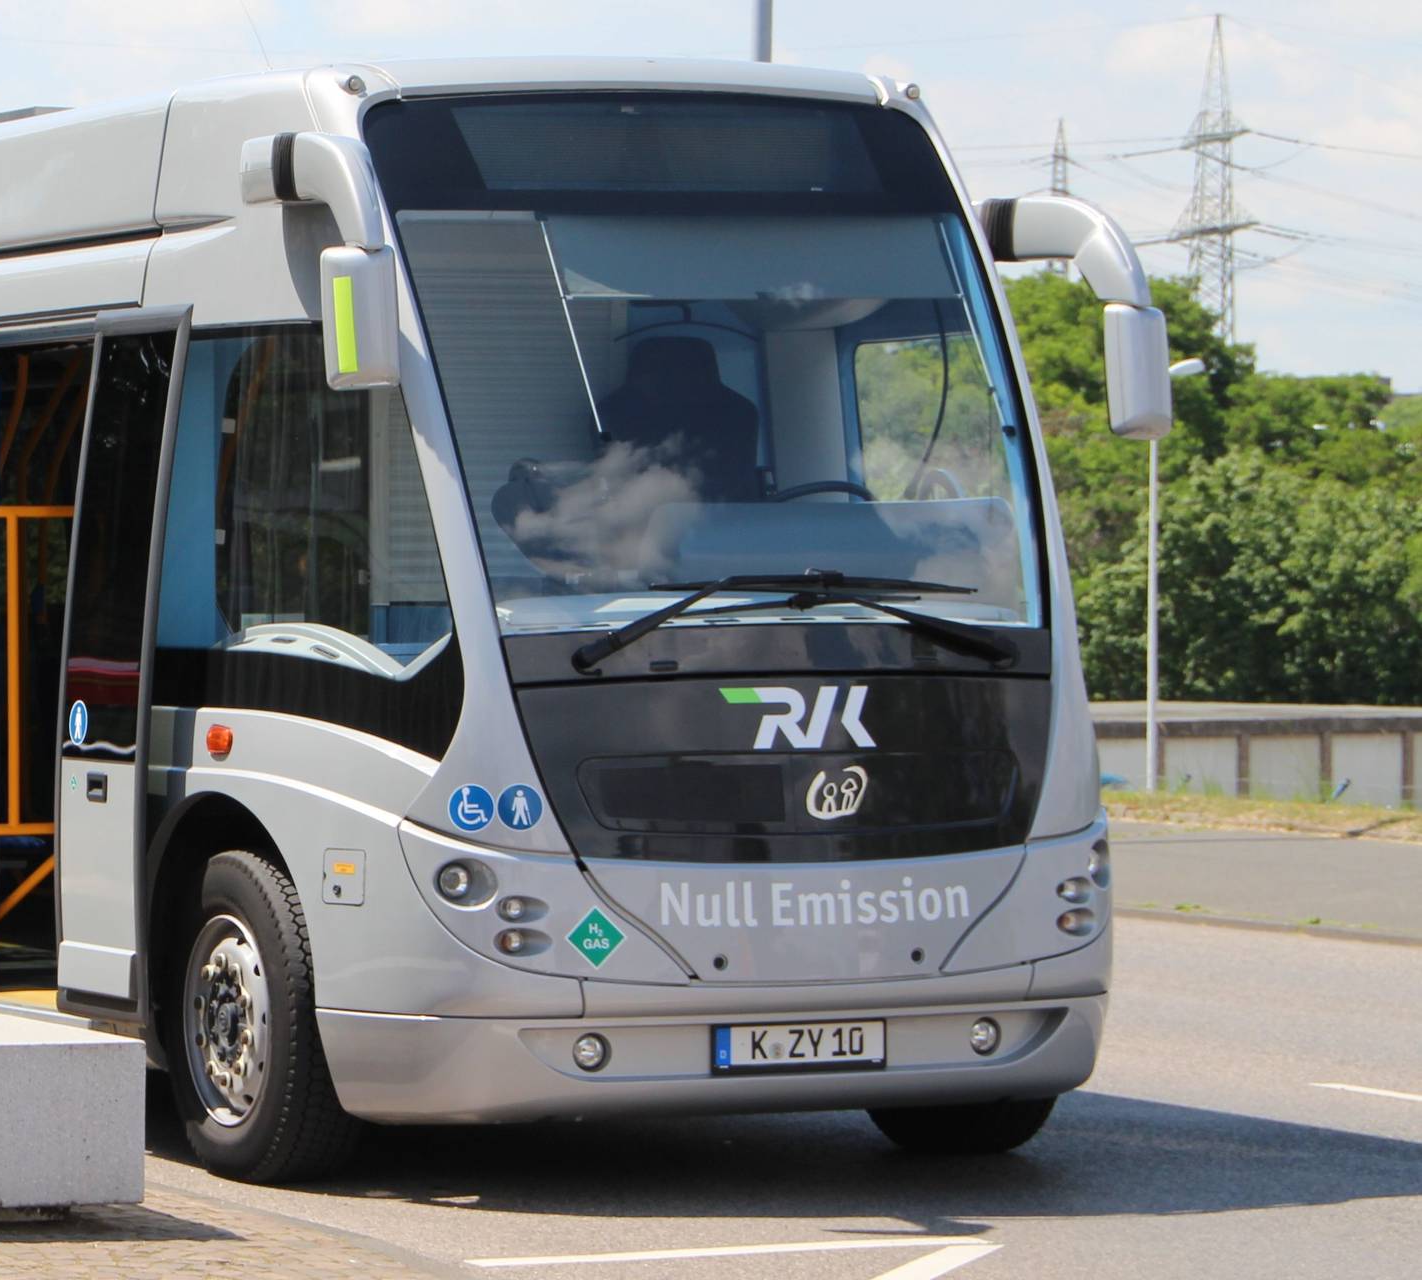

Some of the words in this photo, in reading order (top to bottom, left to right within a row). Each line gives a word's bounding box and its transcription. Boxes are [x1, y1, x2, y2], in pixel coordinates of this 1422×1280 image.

[660, 880, 758, 928] Null
[771, 876, 970, 927] Emission
[582, 938, 610, 950] GAS
[750, 1030, 768, 1060] K
[788, 1028, 823, 1058] ZY
[832, 1026, 864, 1056] 10
